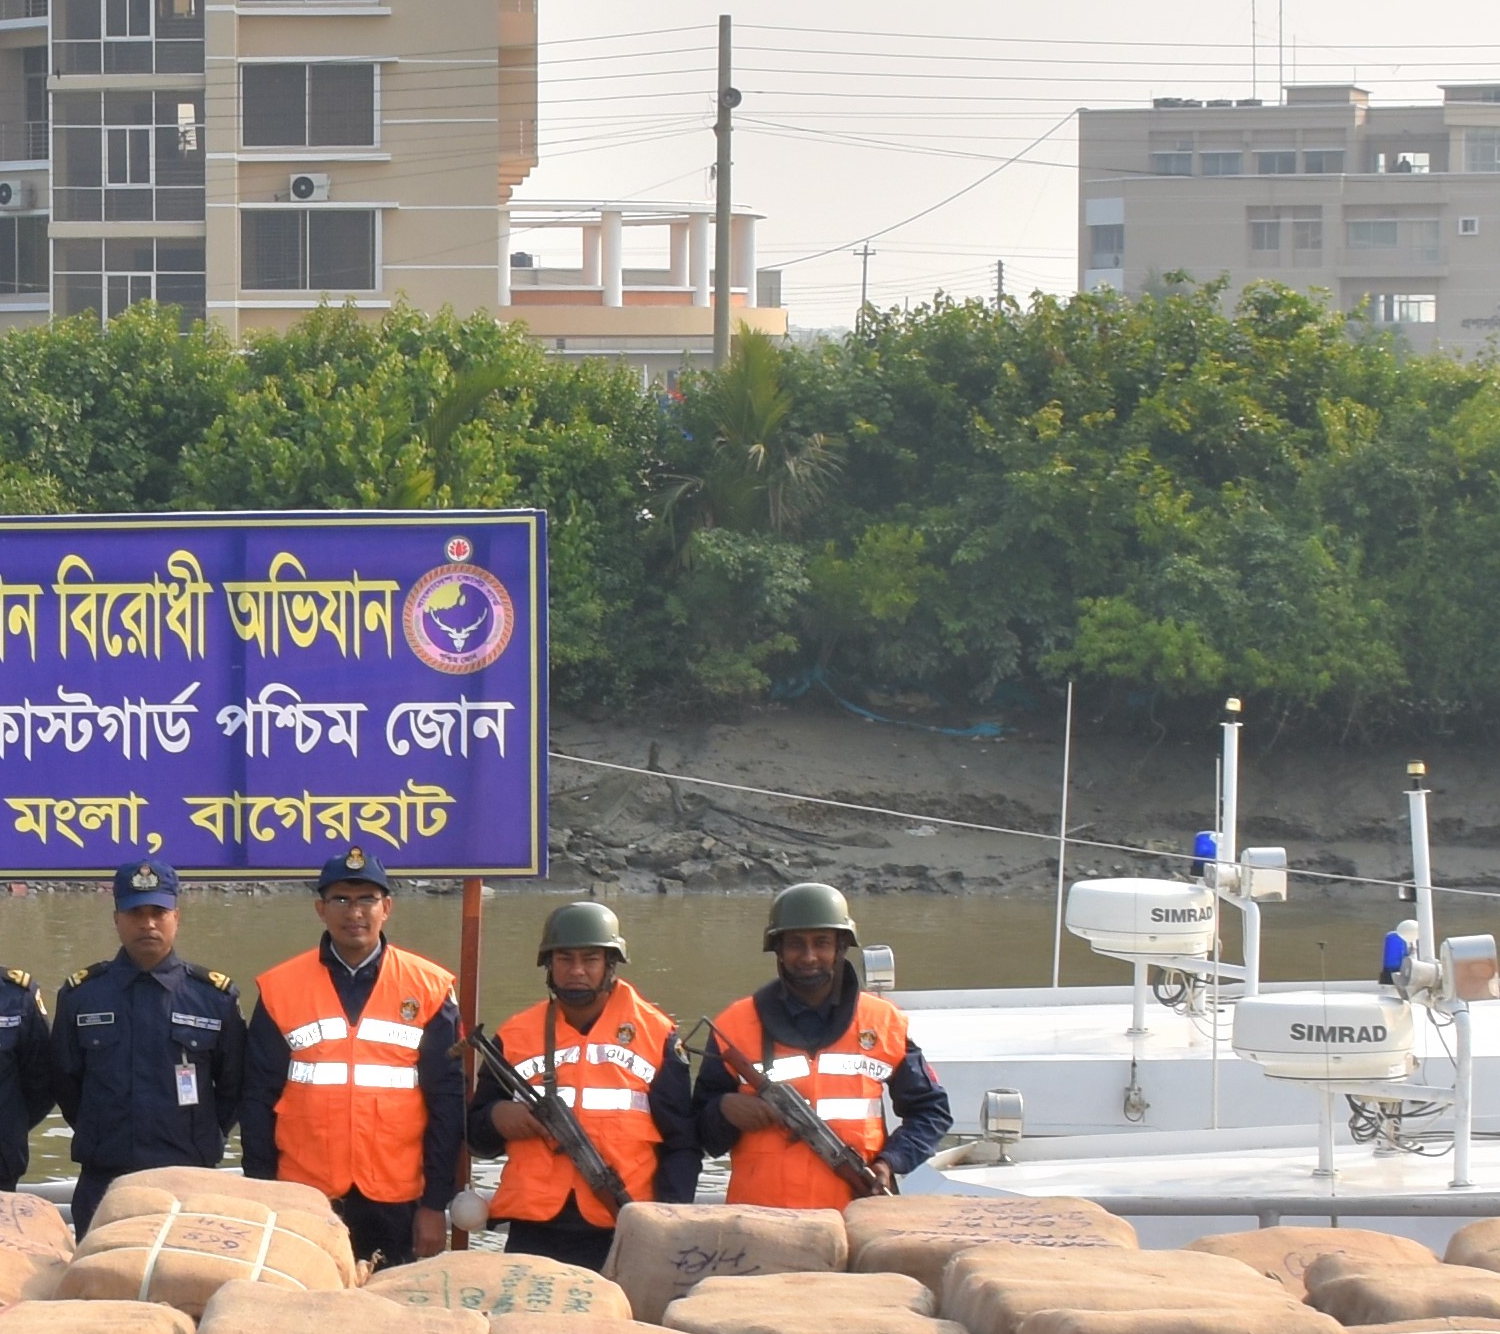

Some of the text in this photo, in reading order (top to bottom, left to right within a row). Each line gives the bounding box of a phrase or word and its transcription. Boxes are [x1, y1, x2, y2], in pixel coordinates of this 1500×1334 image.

[53, 549, 211, 660] বিরোধী
[223, 551, 399, 659] অভিযান
[216, 682, 367, 759] পশ্চিম
[385, 700, 514, 759] জোন
[5, 792, 161, 853] মংলা,
[184, 779, 456, 849] বাগেরহাট
[1150, 906, 1214, 923] SIMRAD
[1289, 1023, 1388, 1043] SIMRAD
